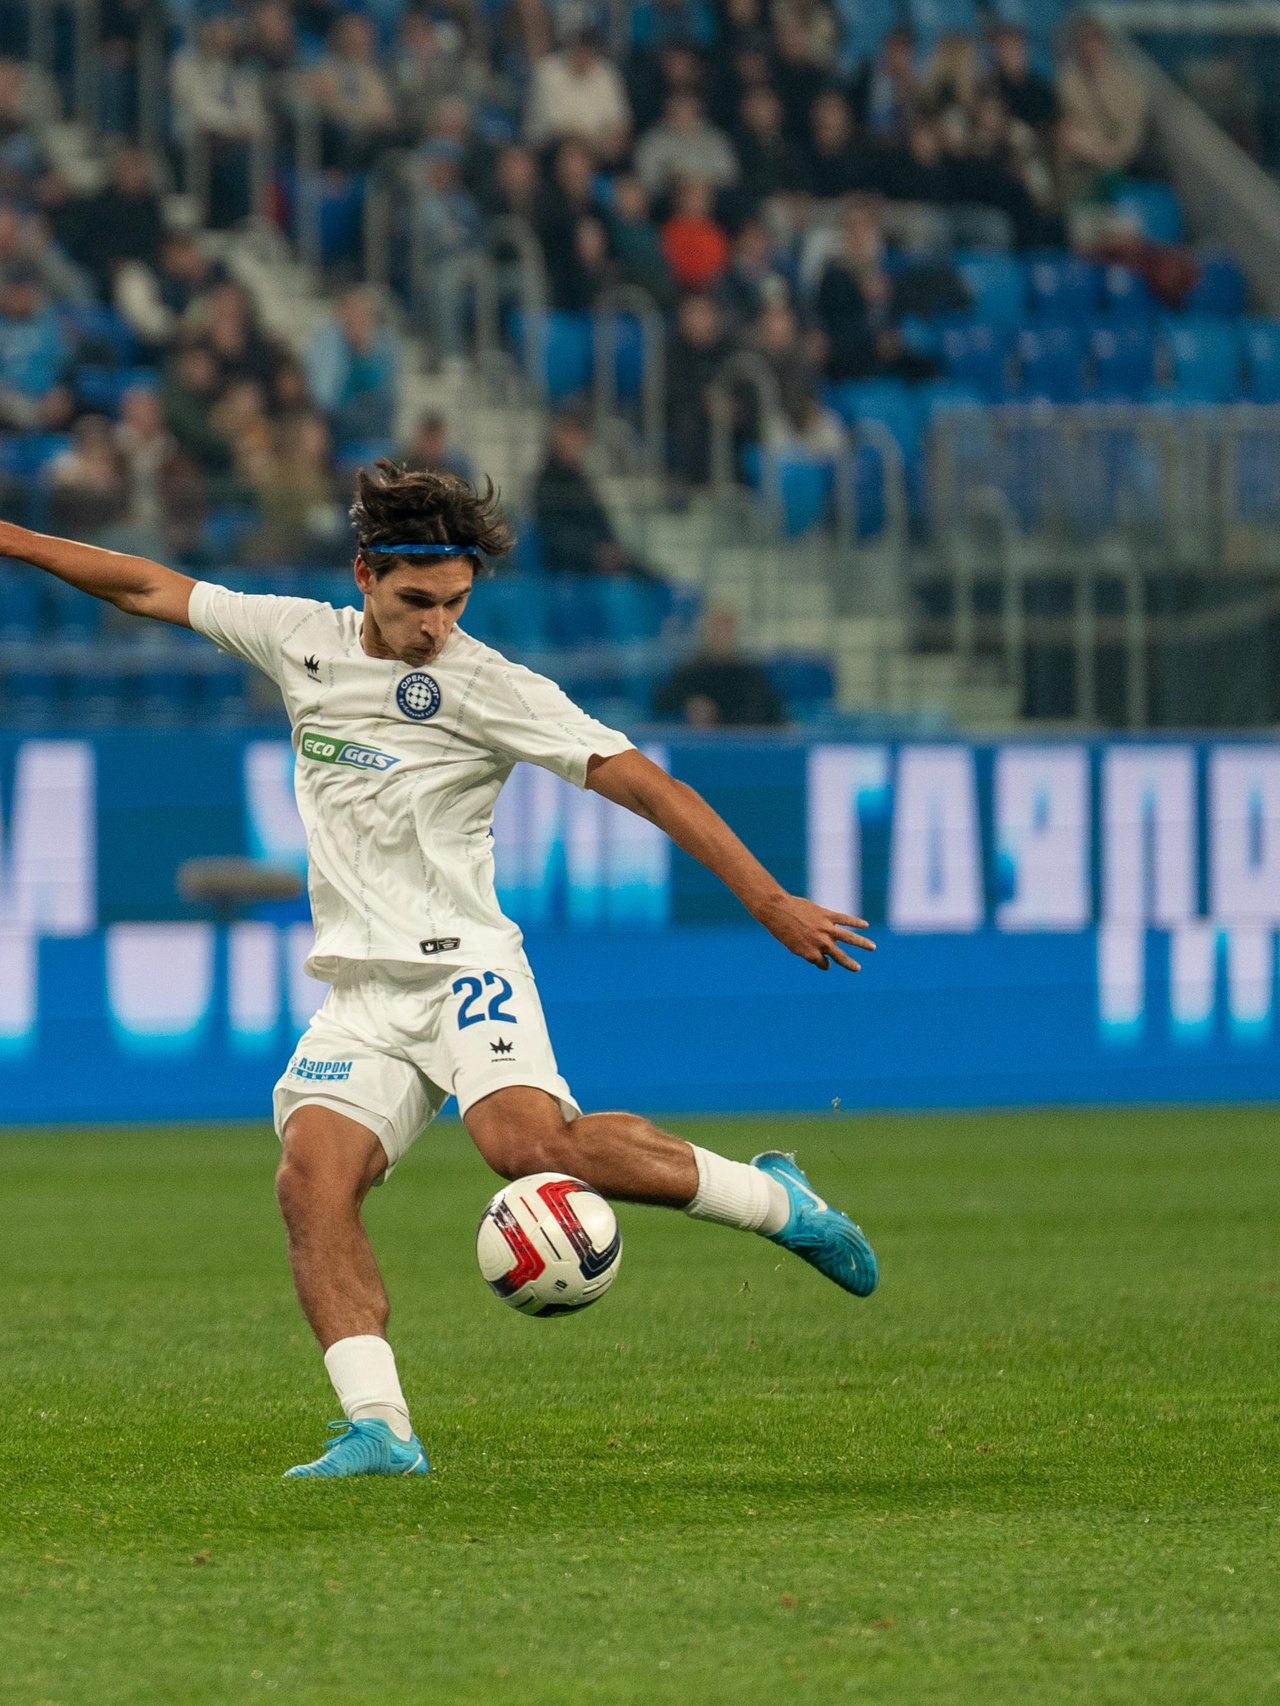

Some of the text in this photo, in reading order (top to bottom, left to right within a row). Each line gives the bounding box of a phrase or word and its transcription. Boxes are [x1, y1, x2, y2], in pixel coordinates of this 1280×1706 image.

[400, 674, 440, 700] ОРЕНБУРГ
[303, 738, 336, 757] ECO
[451, 970, 518, 1031] 22
